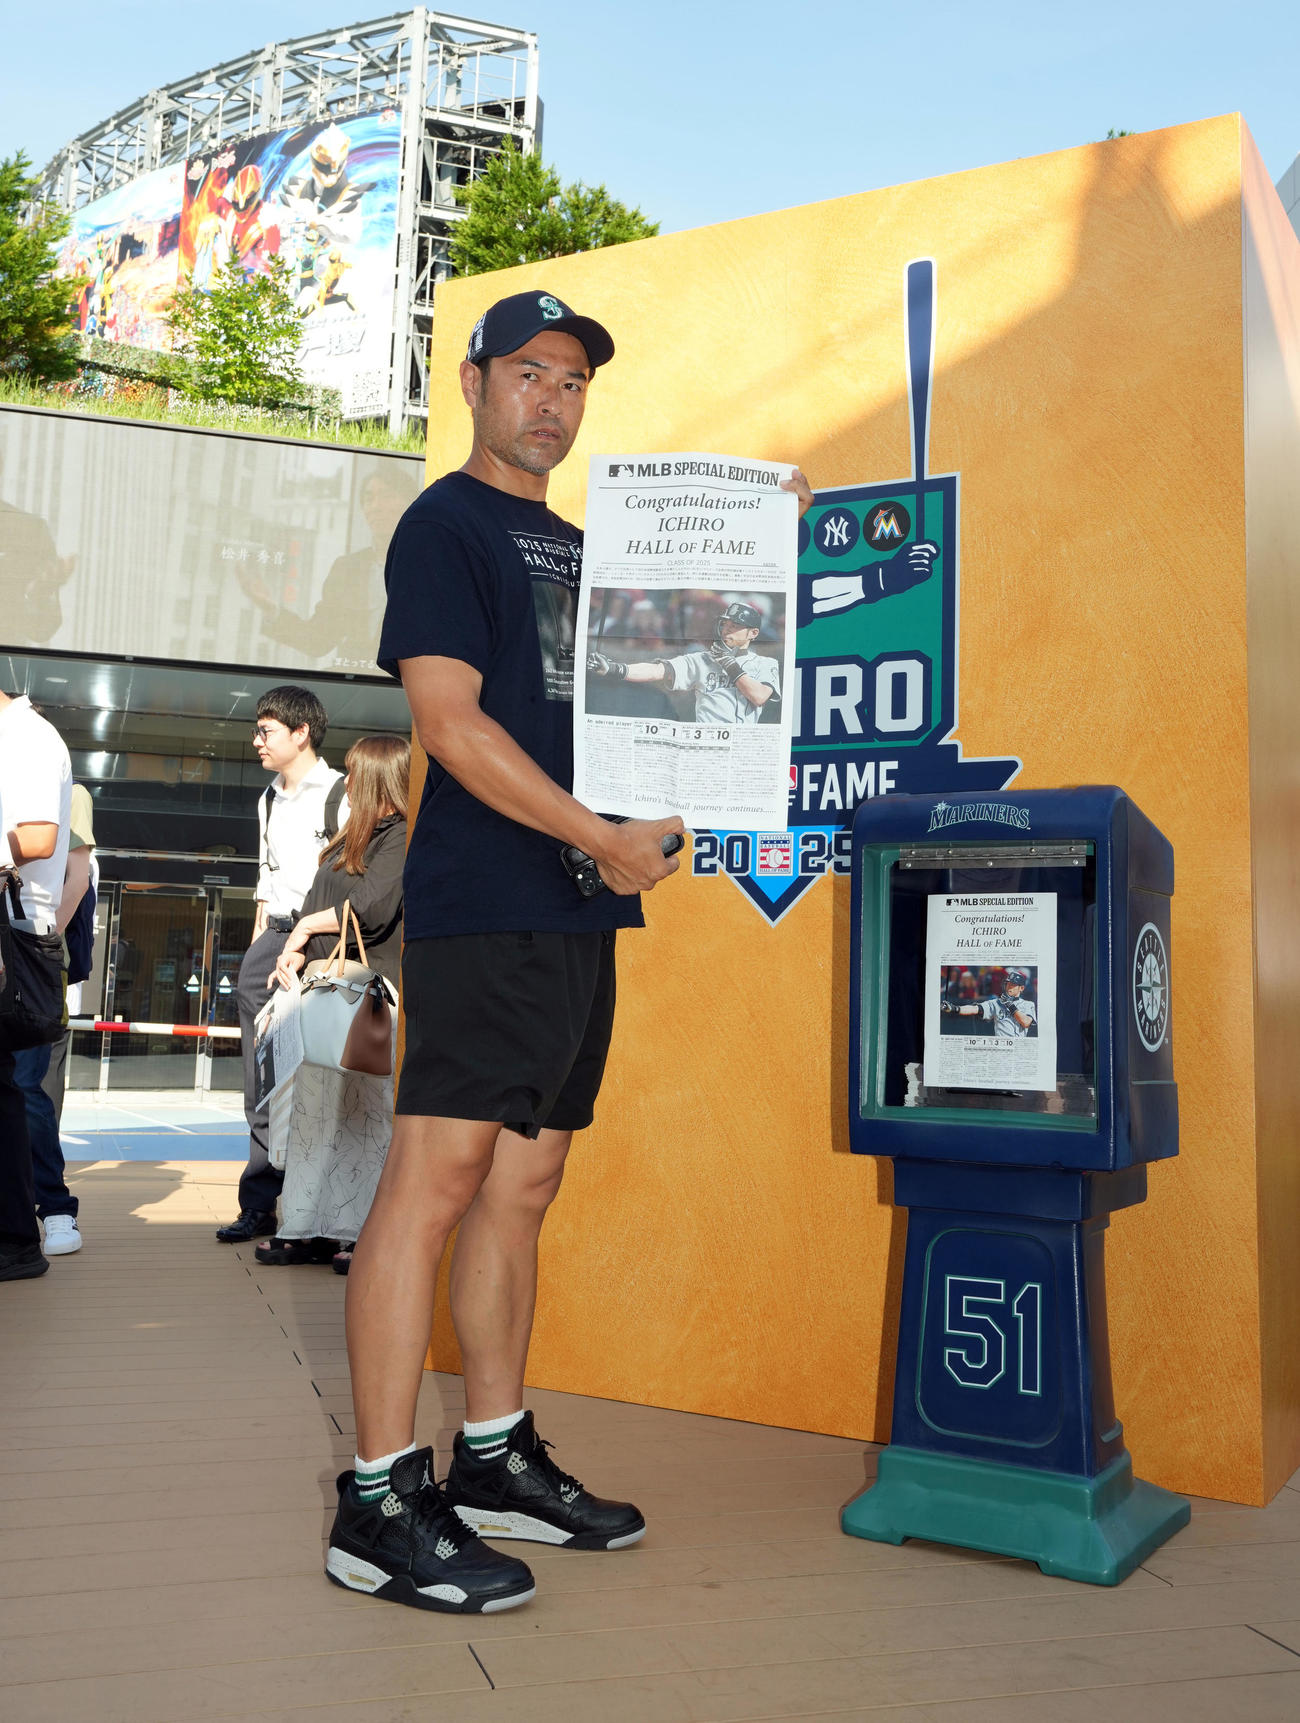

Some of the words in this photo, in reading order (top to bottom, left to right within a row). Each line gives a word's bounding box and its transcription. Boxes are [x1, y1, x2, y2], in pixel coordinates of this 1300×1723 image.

[637, 463, 672, 477] MLB
[674, 461, 726, 479] SPECIAL
[727, 465, 780, 487] EDITION
[625, 493, 761, 513] Congratulations!
[657, 516, 725, 532] ICHIRO
[823, 516, 849, 547] NY
[513, 537, 542, 551] 2025
[625, 540, 674, 555] HALL
[679, 542, 698, 554] OF
[702, 539, 756, 556] FAME
[521, 552, 560, 571] HALL
[791, 659, 924, 737] IRO
[646, 725, 658, 734] 10
[672, 728, 676, 737] 1
[694, 730, 702, 740] 3
[717, 730, 730, 740] 10
[802, 761, 898, 810] FAME
[693, 804, 723, 812] journey
[927, 801, 1030, 832] MARINERS
[692, 833, 752, 876] 20
[960, 898, 978, 906] MLB
[979, 897, 1006, 906] SPECIAL
[1006, 897, 1034, 905] EDITION
[954, 914, 1025, 925] Congratulations!
[972, 927, 1007, 936] ICHIRO
[956, 939, 981, 948] HALL
[983, 940, 994, 948] OF
[994, 939, 1023, 948] FAME
[944, 1274, 1042, 1397] 51
